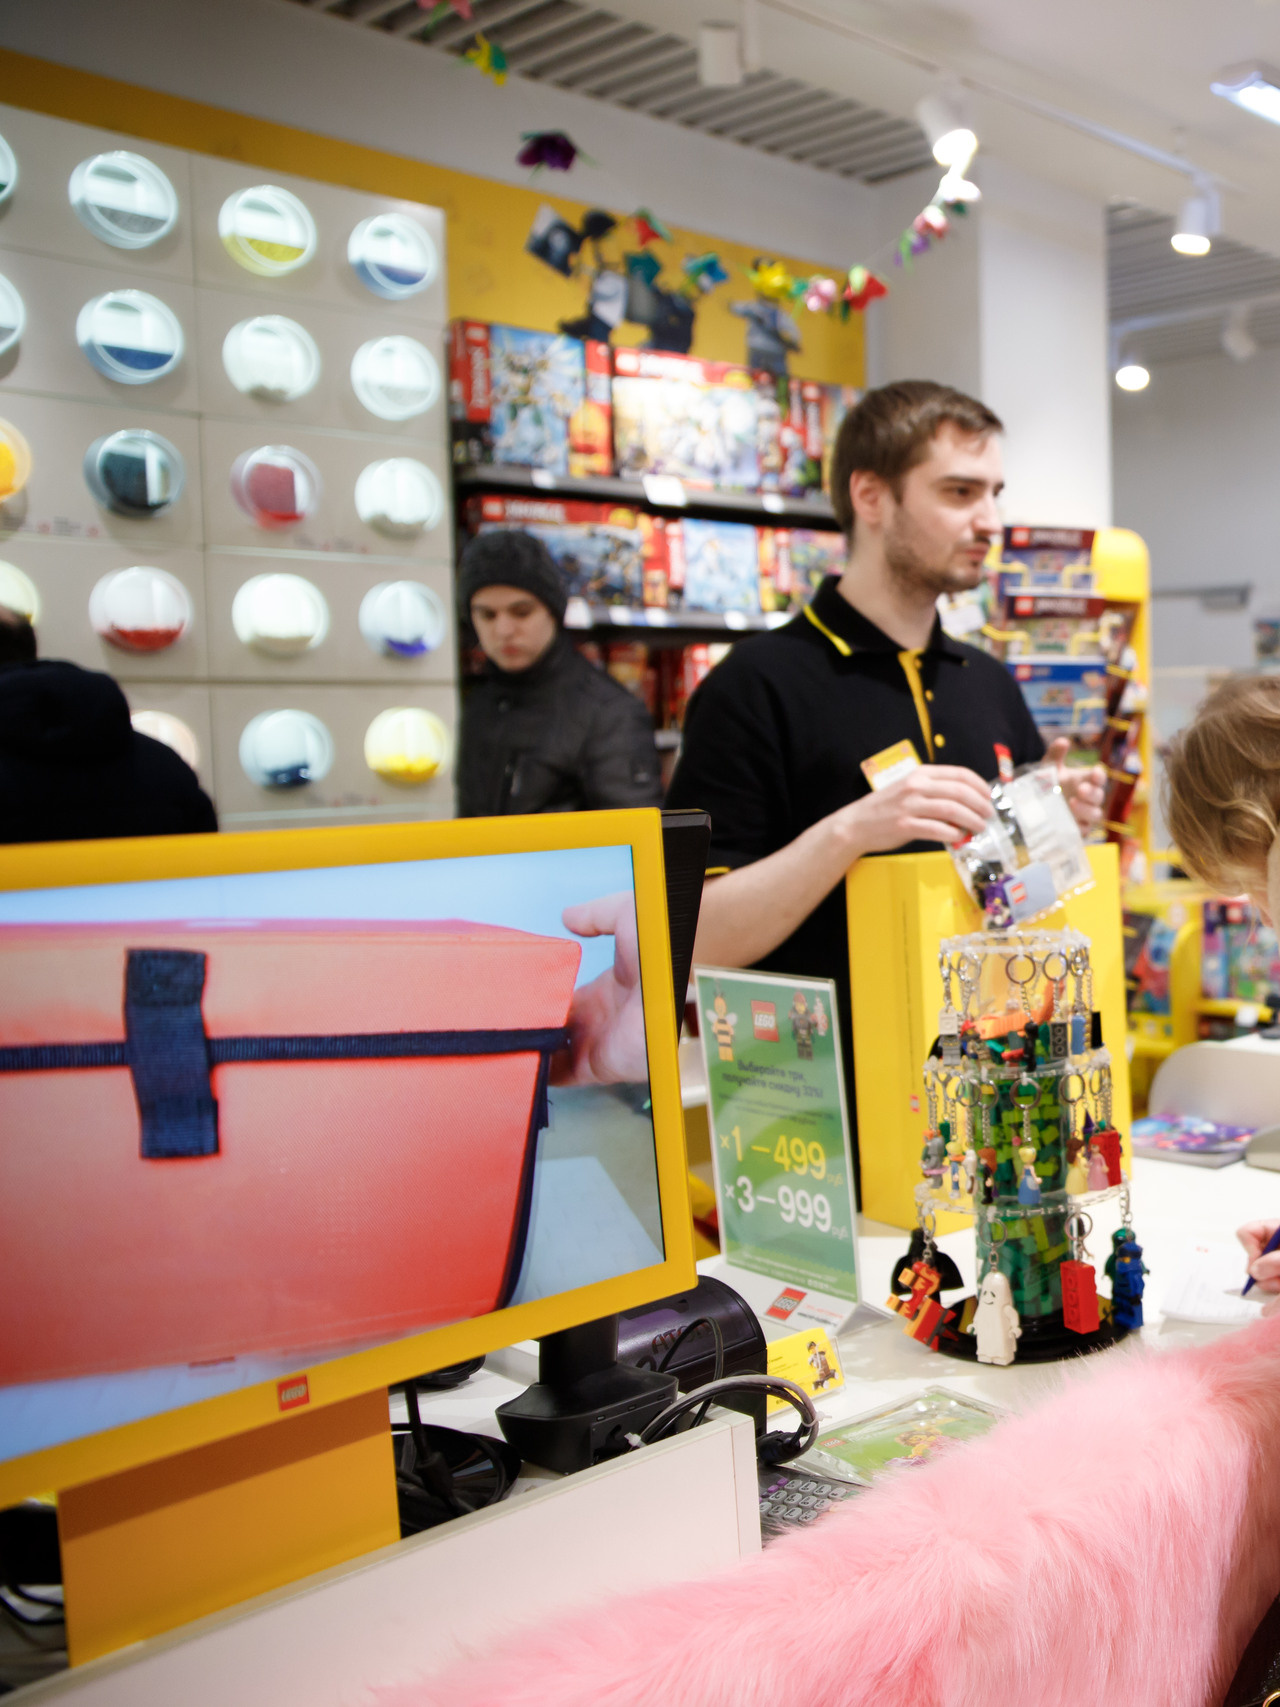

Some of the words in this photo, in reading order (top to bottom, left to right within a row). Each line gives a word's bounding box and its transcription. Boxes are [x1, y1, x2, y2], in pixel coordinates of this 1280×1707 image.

[754, 1013, 776, 1029] LEGO
[771, 1296, 800, 1312] LEGO
[281, 1384, 307, 1403] LEGO
